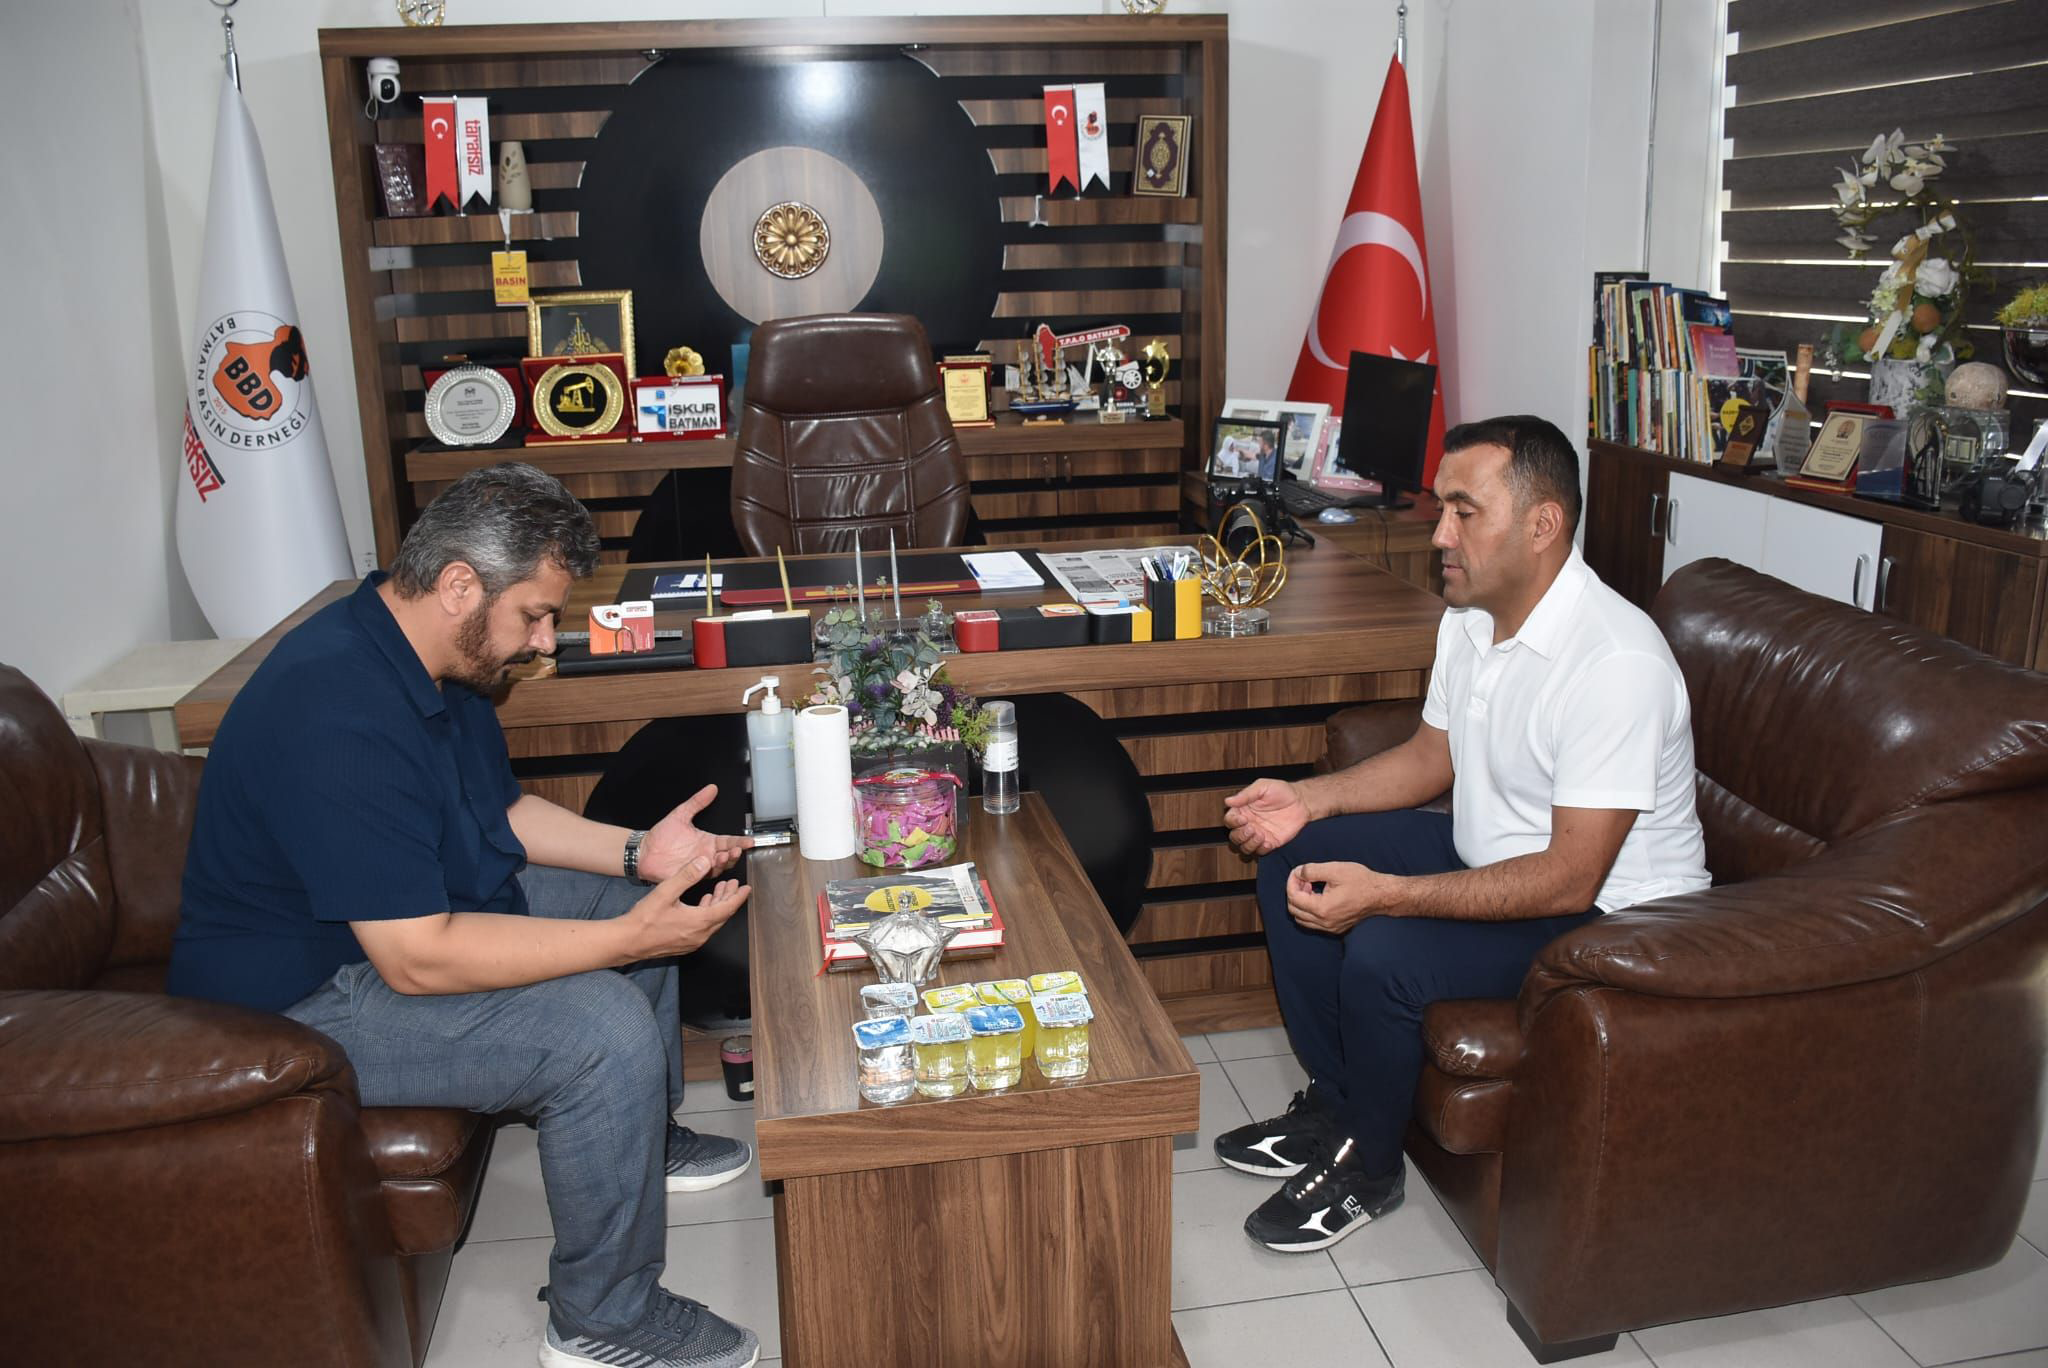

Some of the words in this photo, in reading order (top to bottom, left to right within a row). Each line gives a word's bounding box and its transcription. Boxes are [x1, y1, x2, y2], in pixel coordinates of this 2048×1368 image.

[197, 317, 236, 381] BATMAN
[1086, 328, 1120, 341] BATMAN
[223, 356, 274, 411] BBD
[668, 415, 718, 429] BATMAN
